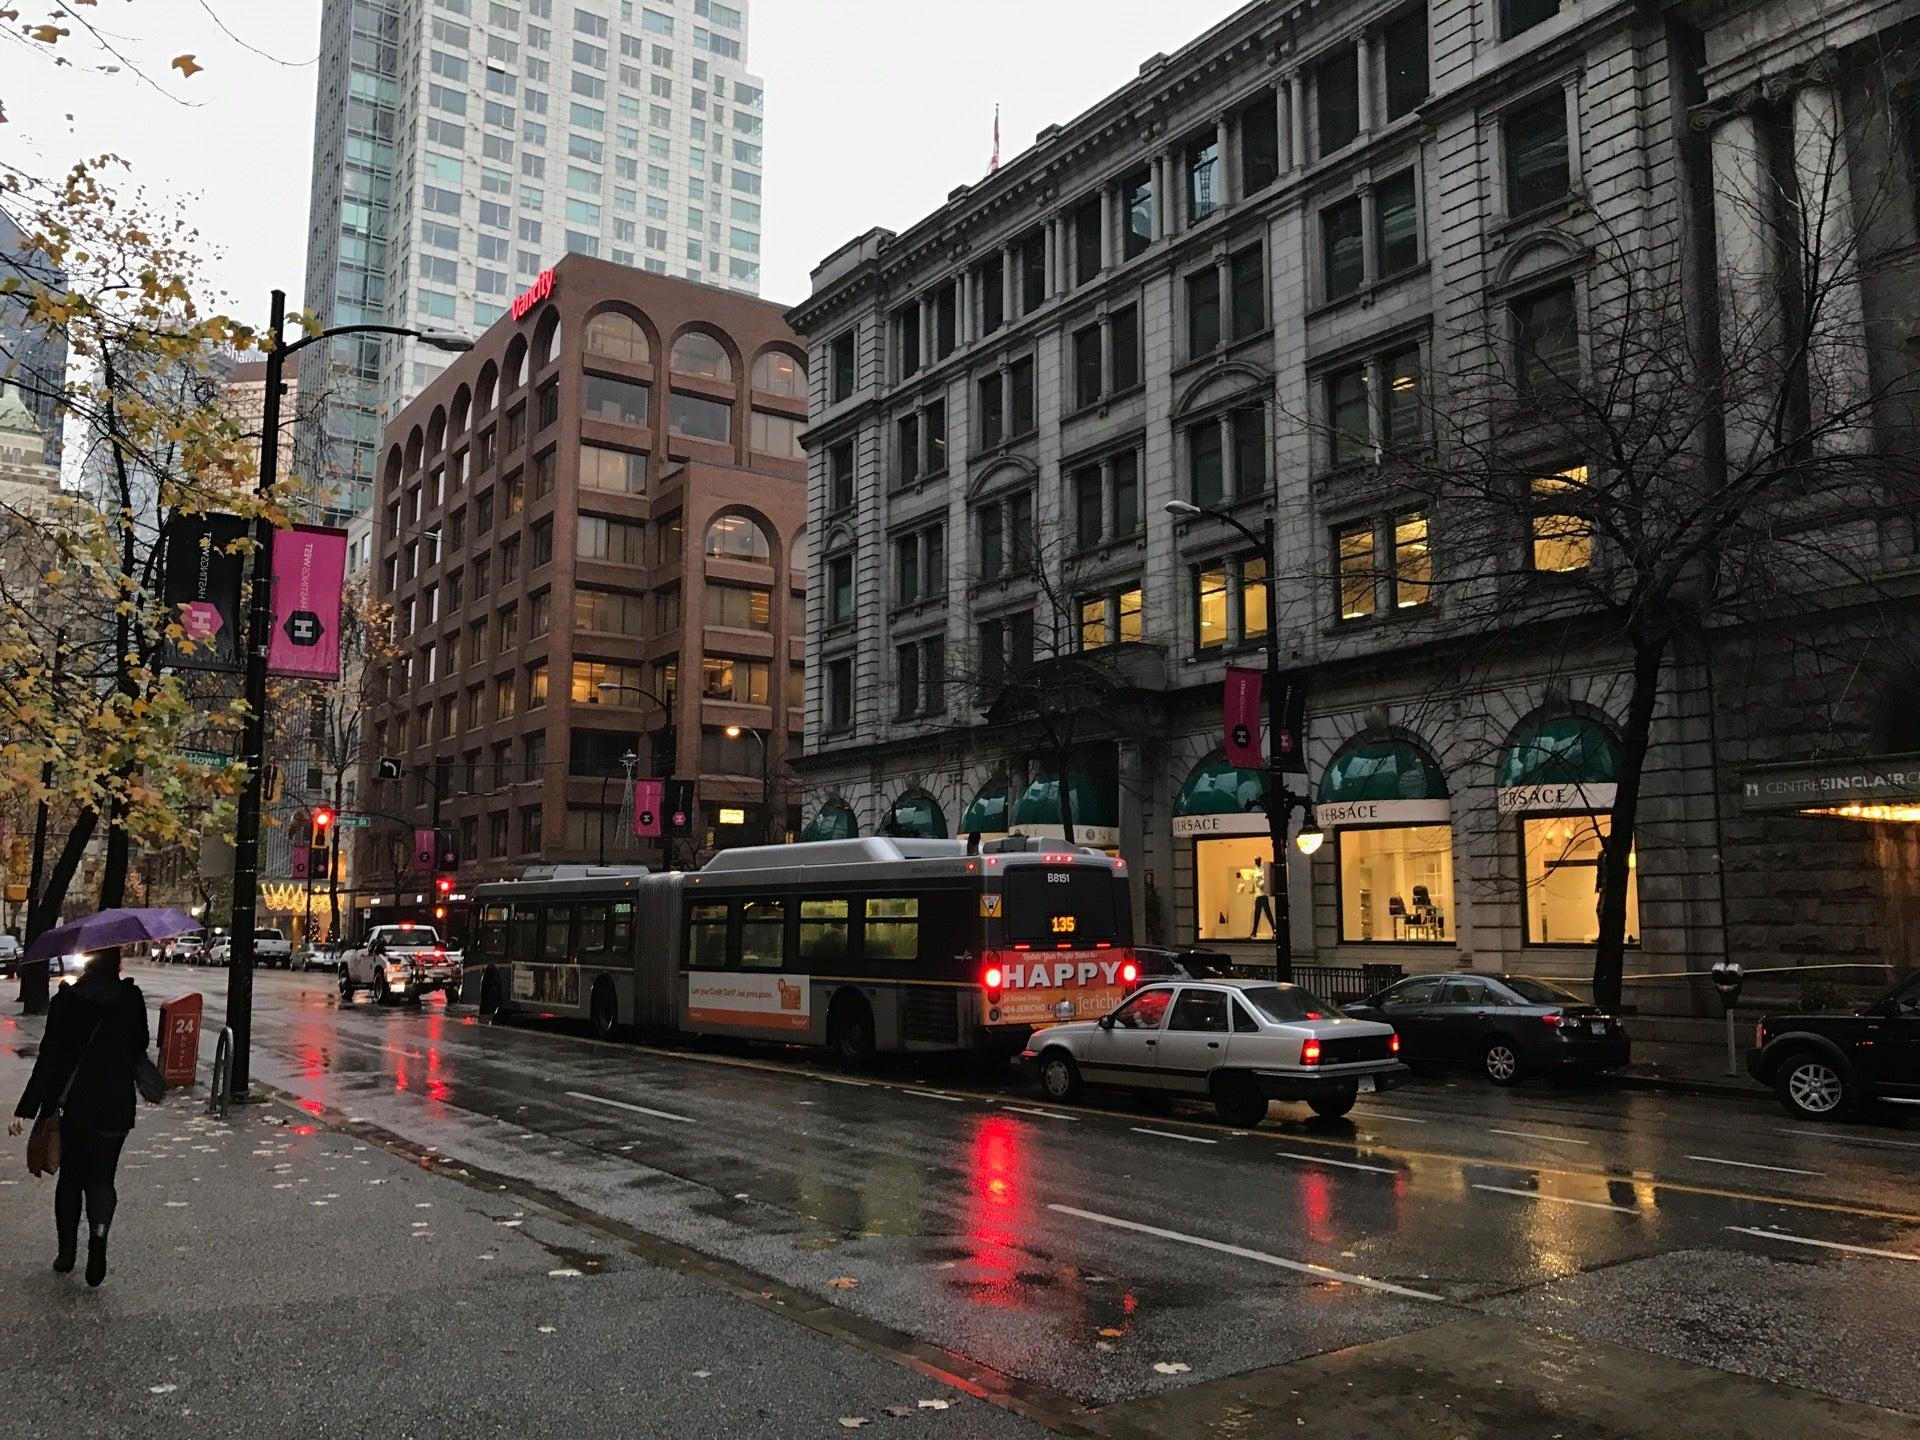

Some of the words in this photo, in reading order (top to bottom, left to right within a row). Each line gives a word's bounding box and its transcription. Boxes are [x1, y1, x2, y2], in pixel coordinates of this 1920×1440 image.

[1502, 788, 1567, 805] ERSACE
[1175, 818, 1221, 832] ERSACE
[1047, 873, 1070, 883] B8151
[1052, 916, 1075, 932] 135
[1002, 961, 1121, 988] HAPPY
[1078, 992, 1121, 1015] jericho
[175, 1018, 194, 1034] 24
